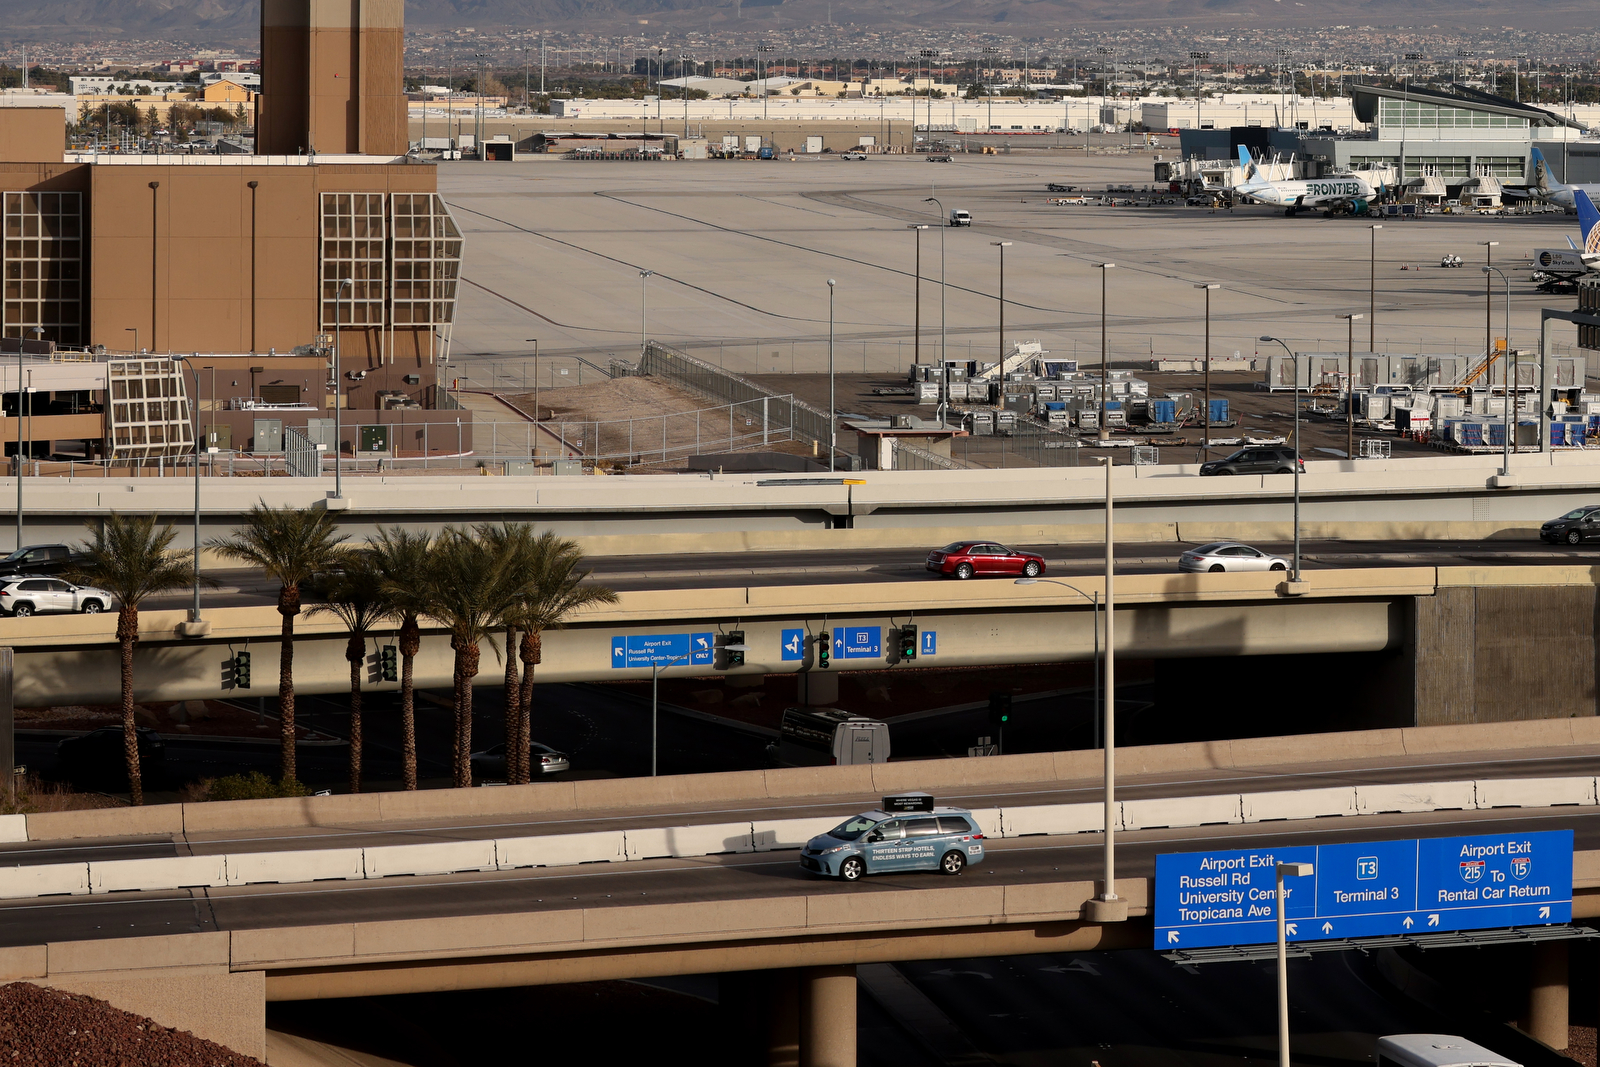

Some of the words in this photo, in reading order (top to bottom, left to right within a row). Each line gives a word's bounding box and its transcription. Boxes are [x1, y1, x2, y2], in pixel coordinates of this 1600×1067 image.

[1306, 183, 1360, 195] FRONTIER
[1460, 843, 1505, 859] Airport
[1508, 841, 1532, 854] Exit
[1200, 856, 1245, 872] Airport
[1249, 854, 1274, 868] Exit
[1359, 862, 1376, 874] T3
[1180, 874, 1227, 888] Russell
[1232, 872, 1250, 885] Rd
[1465, 867, 1480, 879] 215
[1490, 870, 1505, 882] To
[1515, 864, 1527, 876] 15
[1180, 890, 1244, 905] University
[1248, 888, 1292, 901] Cener
[1334, 887, 1387, 903] Terminal
[1391, 887, 1399, 899] 3
[1438, 888, 1478, 902] Rental
[1482, 887, 1505, 899] Car
[1509, 885, 1550, 897] Return
[1178, 907, 1243, 922] Tropicana
[1248, 904, 1271, 916] Ave
